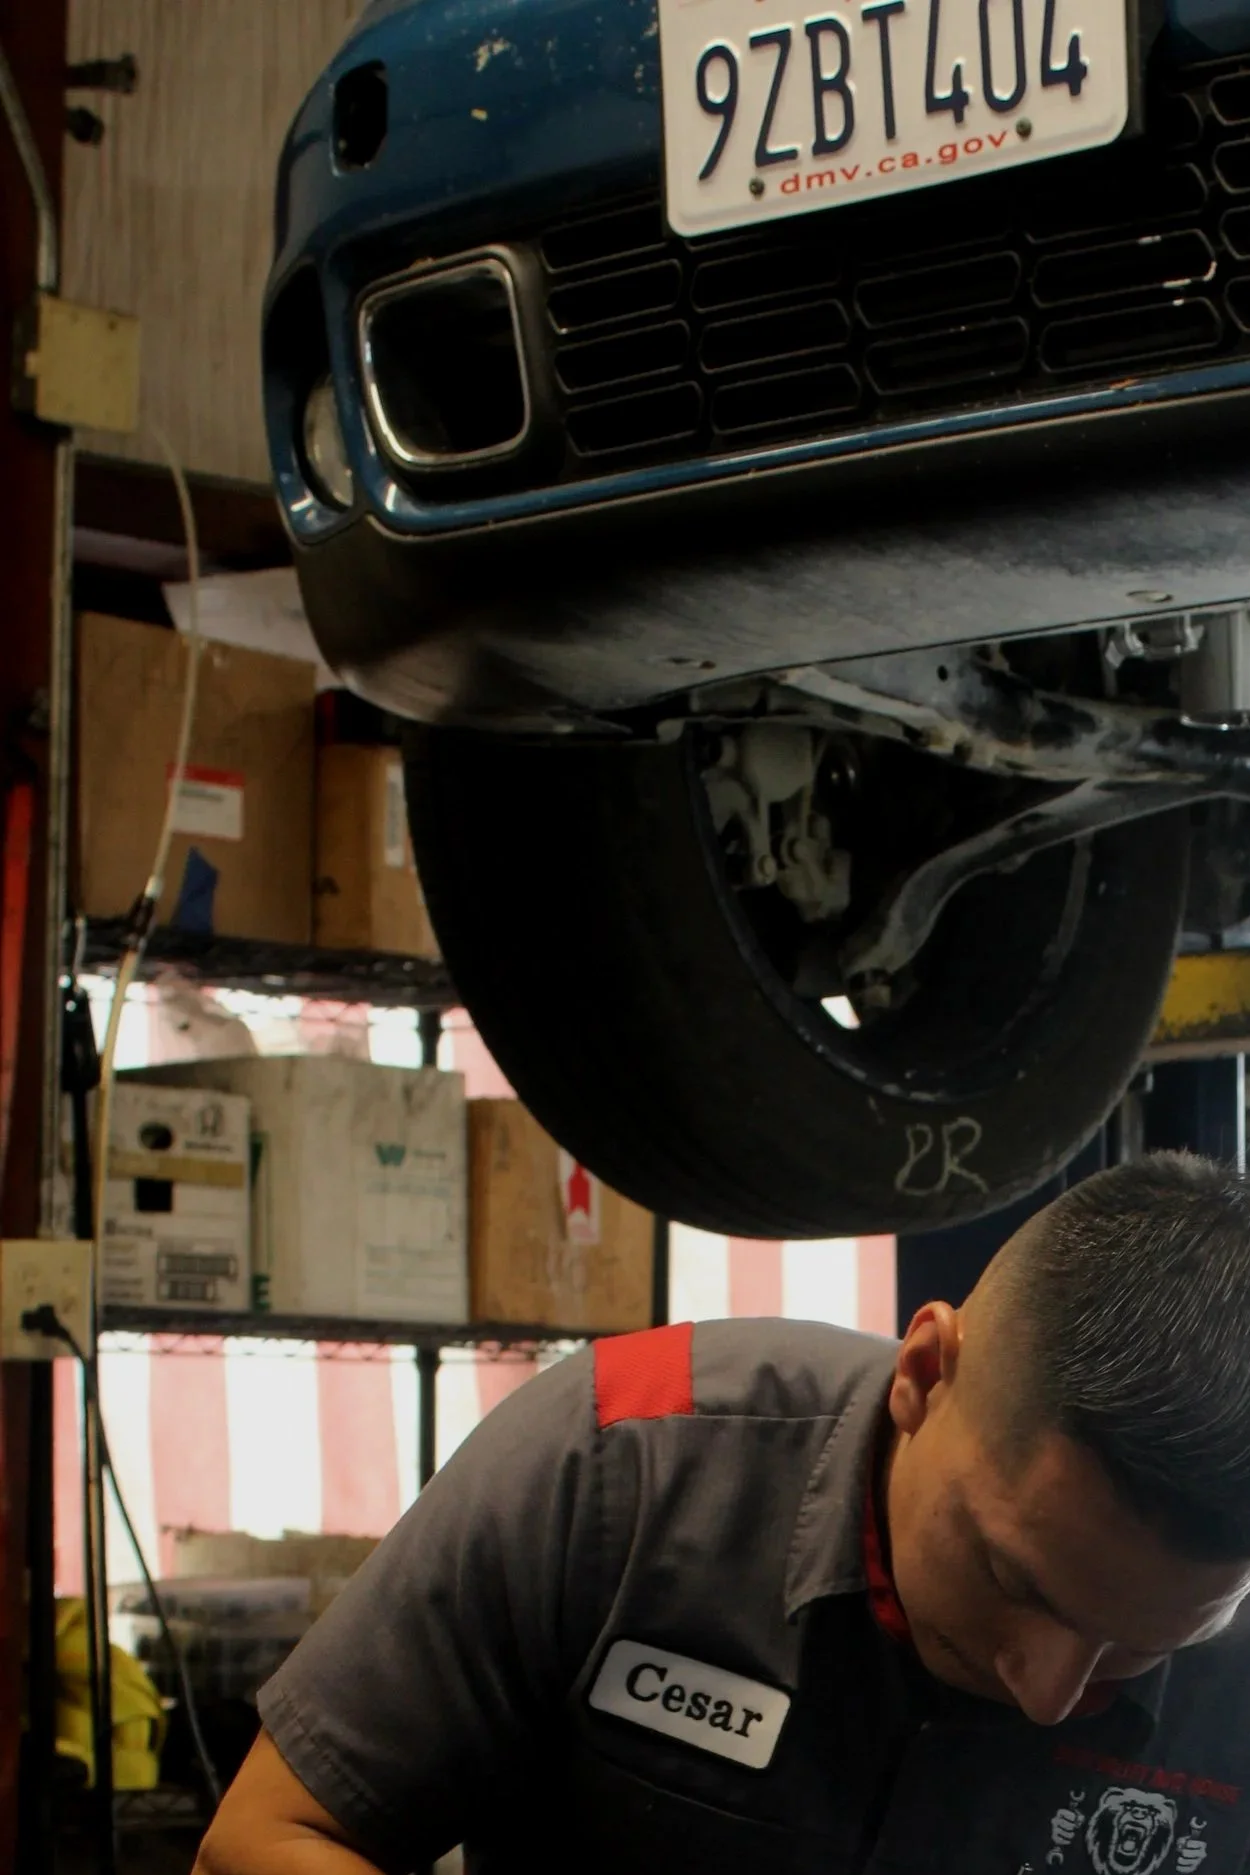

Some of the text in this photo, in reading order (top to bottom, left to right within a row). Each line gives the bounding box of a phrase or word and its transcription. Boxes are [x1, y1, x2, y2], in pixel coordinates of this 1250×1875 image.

[694, 0, 1090, 182] 9ZBT404
[779, 129, 1010, 196] dmv.ca.gov
[626, 1662, 764, 1738] Cesar
